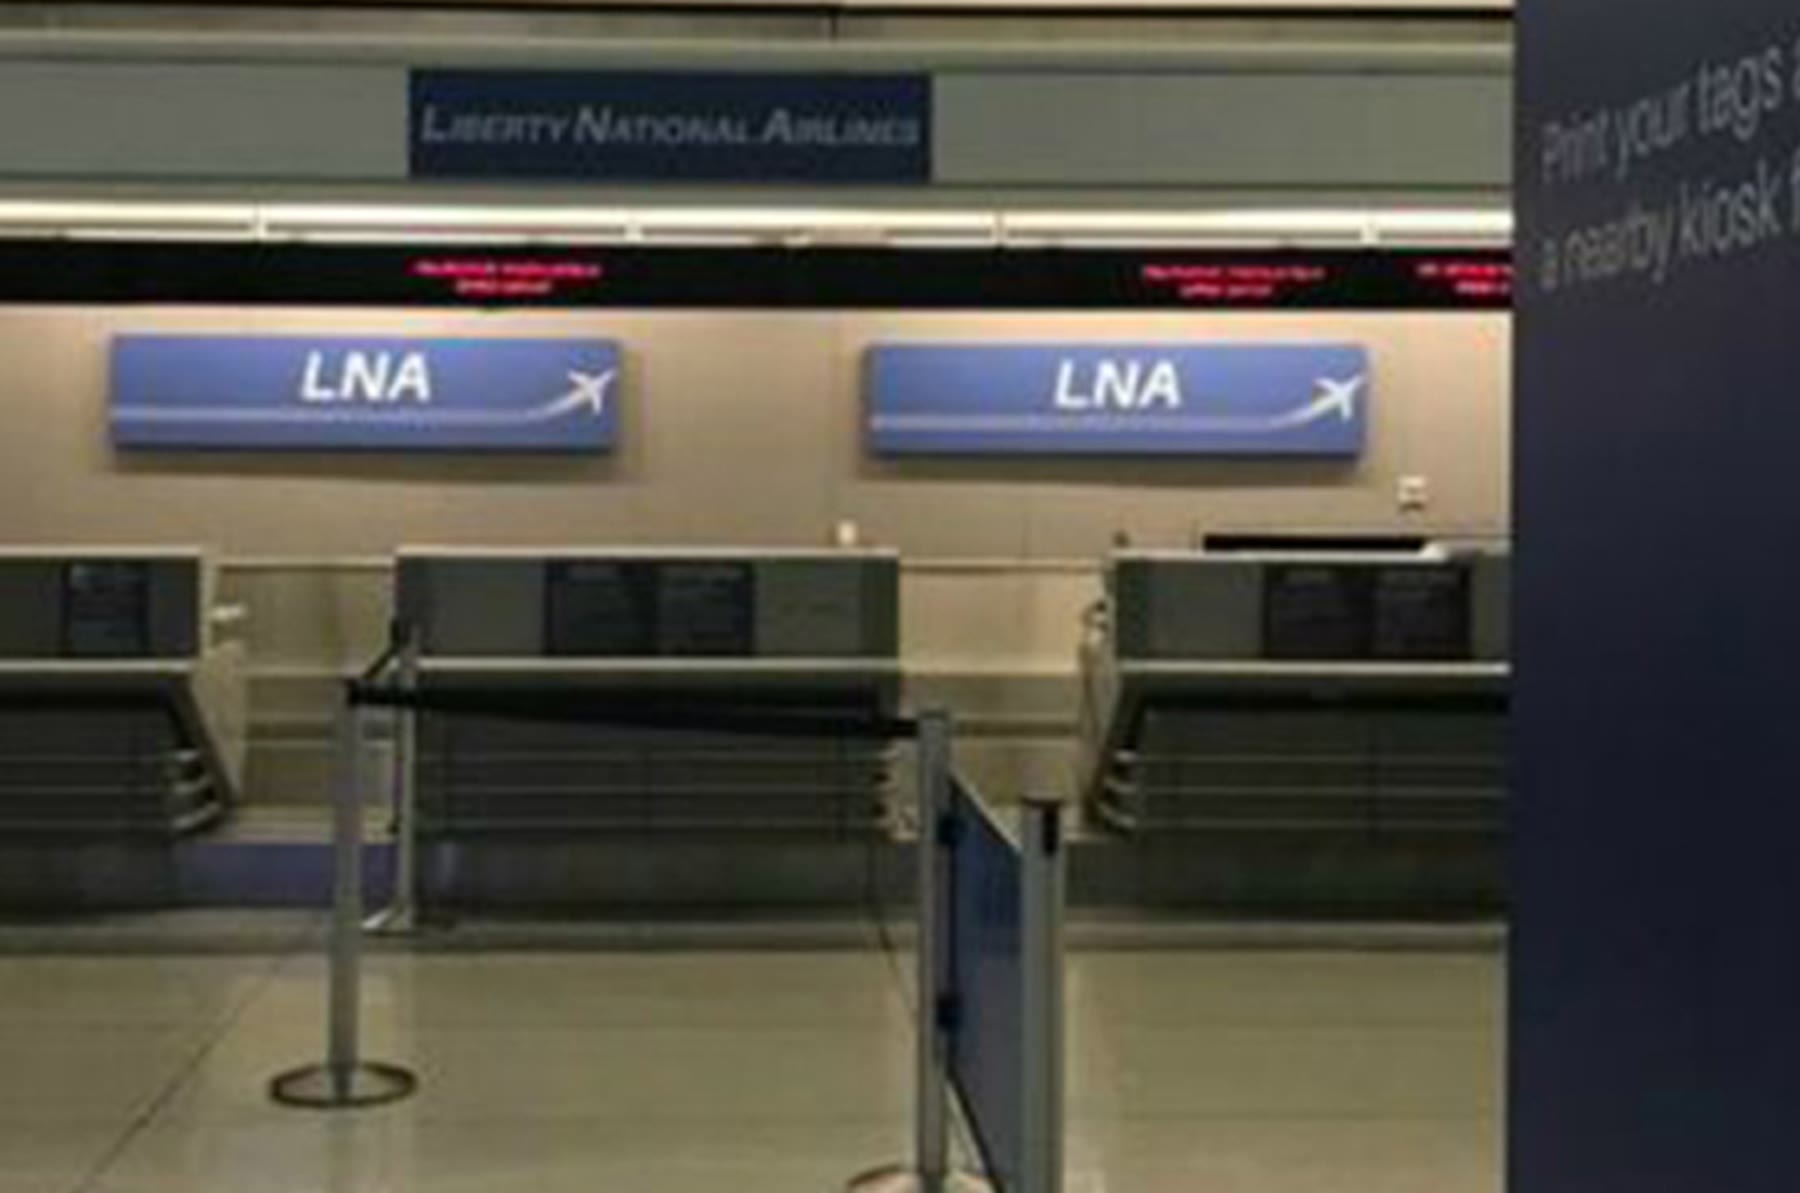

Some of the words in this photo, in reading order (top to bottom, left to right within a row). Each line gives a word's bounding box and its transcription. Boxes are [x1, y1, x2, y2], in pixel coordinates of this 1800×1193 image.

[1614, 80, 1691, 182] your
[1697, 44, 1783, 141] tags
[1563, 198, 1674, 285] nearby
[1678, 154, 1783, 258] kiosk
[300, 349, 432, 402] LNA
[1053, 357, 1182, 409] LNA
